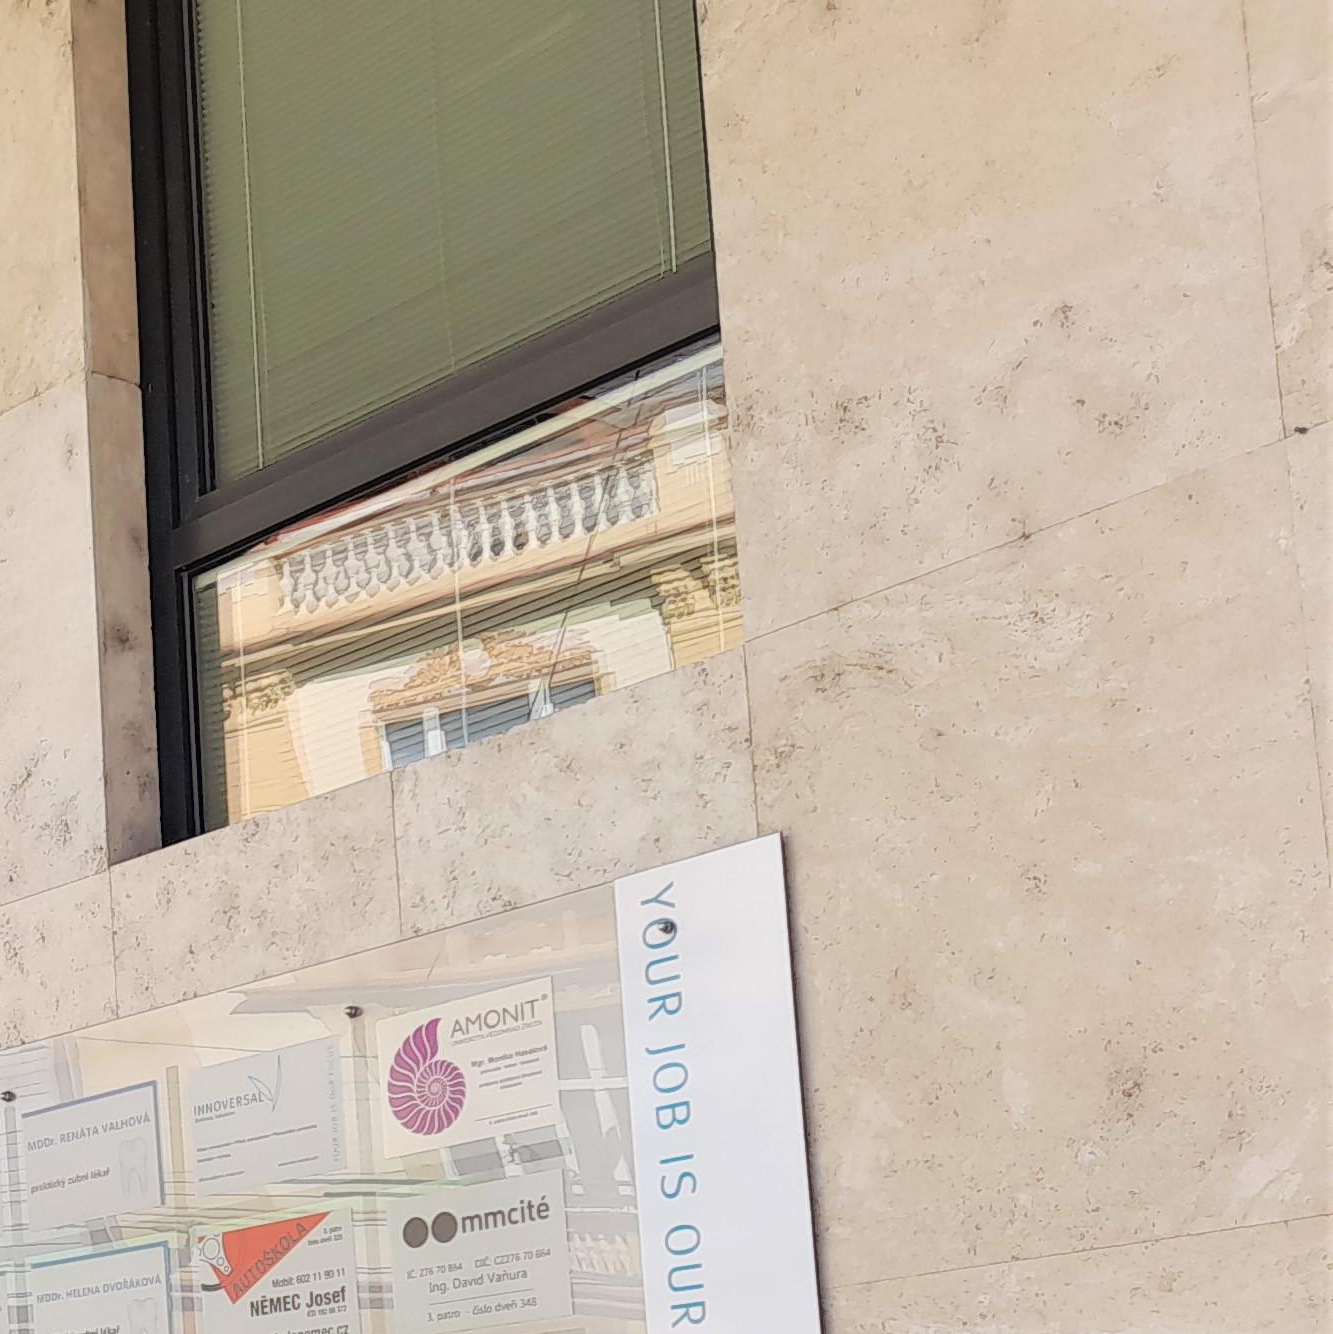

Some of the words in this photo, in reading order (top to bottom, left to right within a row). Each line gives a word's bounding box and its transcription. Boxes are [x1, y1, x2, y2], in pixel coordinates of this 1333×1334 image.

[640, 881, 683, 1021] YOUR
[194, 1091, 265, 1116] INNOVERSAL
[645, 1043, 691, 1130] JOB
[60, 1126, 99, 1145] RENÁTA
[102, 1112, 150, 1134] VALHOVÁ
[659, 1154, 697, 1199] IS
[461, 1195, 550, 1234] mmcité
[233, 1222, 307, 1296] AUTOŠKOLA
[665, 1224, 707, 1328] OUR
[66, 1285, 101, 1300] HELENA
[250, 1294, 301, 1317] NĚMEC
[306, 1286, 346, 1308] Josef
[429, 1281, 449, 1295] Ing.
[452, 1275, 484, 1290] David
